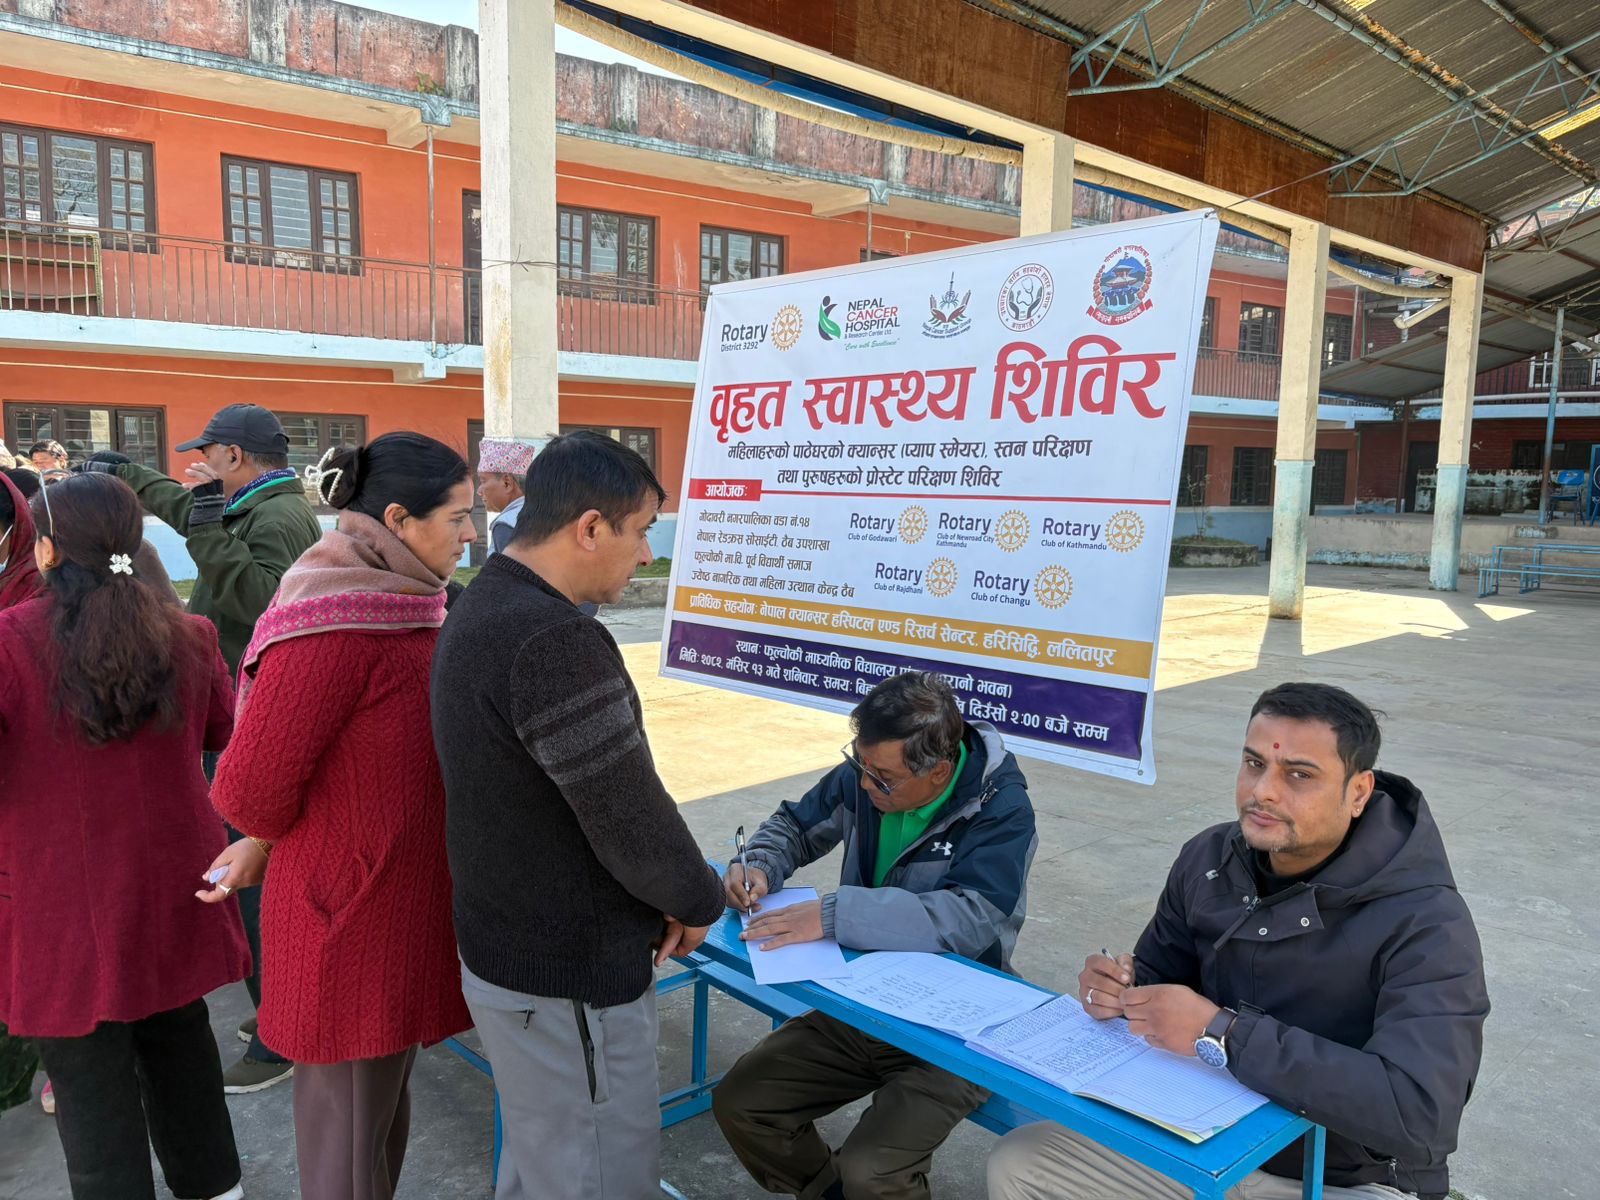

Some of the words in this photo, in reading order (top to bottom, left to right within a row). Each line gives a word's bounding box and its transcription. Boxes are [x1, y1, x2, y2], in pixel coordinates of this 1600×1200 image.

[846, 306, 898, 322] CANCER
[848, 297, 885, 312] NEPAL
[721, 323, 768, 343] Rotary
[845, 317, 901, 332] HOSPITAL
[720, 342, 742, 352] District
[743, 341, 758, 350] 3292
[710, 380, 792, 443] वृहत
[802, 366, 977, 431] स्वास्थ्य
[990, 334, 1177, 424] शिविर
[793, 440, 844, 460] पाठेघरको
[847, 443, 897, 459] क्यान्सर
[901, 442, 936, 459] (प्याप
[994, 440, 1028, 459] स्तन
[1033, 434, 1093, 459] परिक्षण
[777, 469, 799, 484] तथा
[866, 465, 904, 487] प्रोस्टेट
[908, 465, 957, 487] परिक्षण
[960, 465, 1003, 487] शिविर
[699, 509, 725, 524] गोदावरी
[727, 511, 772, 526] नगरपालिका
[773, 515, 788, 527] वडा
[849, 513, 895, 534] Rotary
[938, 512, 992, 536] Rotary
[848, 533, 860, 541] Club
[861, 533, 868, 541] of
[868, 534, 898, 543] Godawari
[936, 532, 949, 540] Club
[950, 533, 957, 541] of
[957, 533, 982, 542] Newroad
[983, 534, 995, 544] City
[1042, 517, 1101, 541] Rotary
[696, 528, 716, 543] नेपाल
[796, 538, 831, 551] उपशाखा
[936, 540, 968, 549] Kathmandu
[1040, 539, 1056, 548] Club
[1057, 539, 1066, 548] of
[1066, 540, 1108, 551] Kathmandu
[746, 553, 757, 568] पूर्व
[758, 553, 785, 569] विद्यार्थी
[787, 559, 813, 571] समाज
[712, 570, 741, 585] नागरिक
[742, 575, 758, 587] तथा
[760, 574, 786, 590] महिला
[787, 580, 816, 594] उत्थान
[817, 580, 839, 598] केन्द्र
[874, 562, 923, 586] Rotary
[973, 570, 1030, 596] Rotary
[874, 582, 887, 591] Club
[888, 583, 895, 592] of
[896, 584, 924, 595] Rajdhani
[970, 592, 988, 602] Club
[989, 592, 998, 603] of
[1000, 594, 1031, 608] Changu
[760, 601, 787, 619] नेपाल
[789, 607, 828, 626] क्यान्सर
[832, 610, 875, 632] हस्पिटल
[878, 618, 901, 634] एण्ड
[904, 618, 937, 640] रिसर्च
[1046, 637, 1117, 668] ललितपुर
[804, 651, 852, 670] माध्यमिक
[854, 656, 896, 678] विद्यालय
[976, 679, 1013, 698] भवन)
[726, 656, 751, 674] मंसिर
[752, 663, 763, 676] १३
[766, 664, 781, 680] गते
[969, 698, 1009, 724] दिउँसो
[1044, 713, 1070, 735] बजे
[1072, 720, 1110, 742] सम्म
